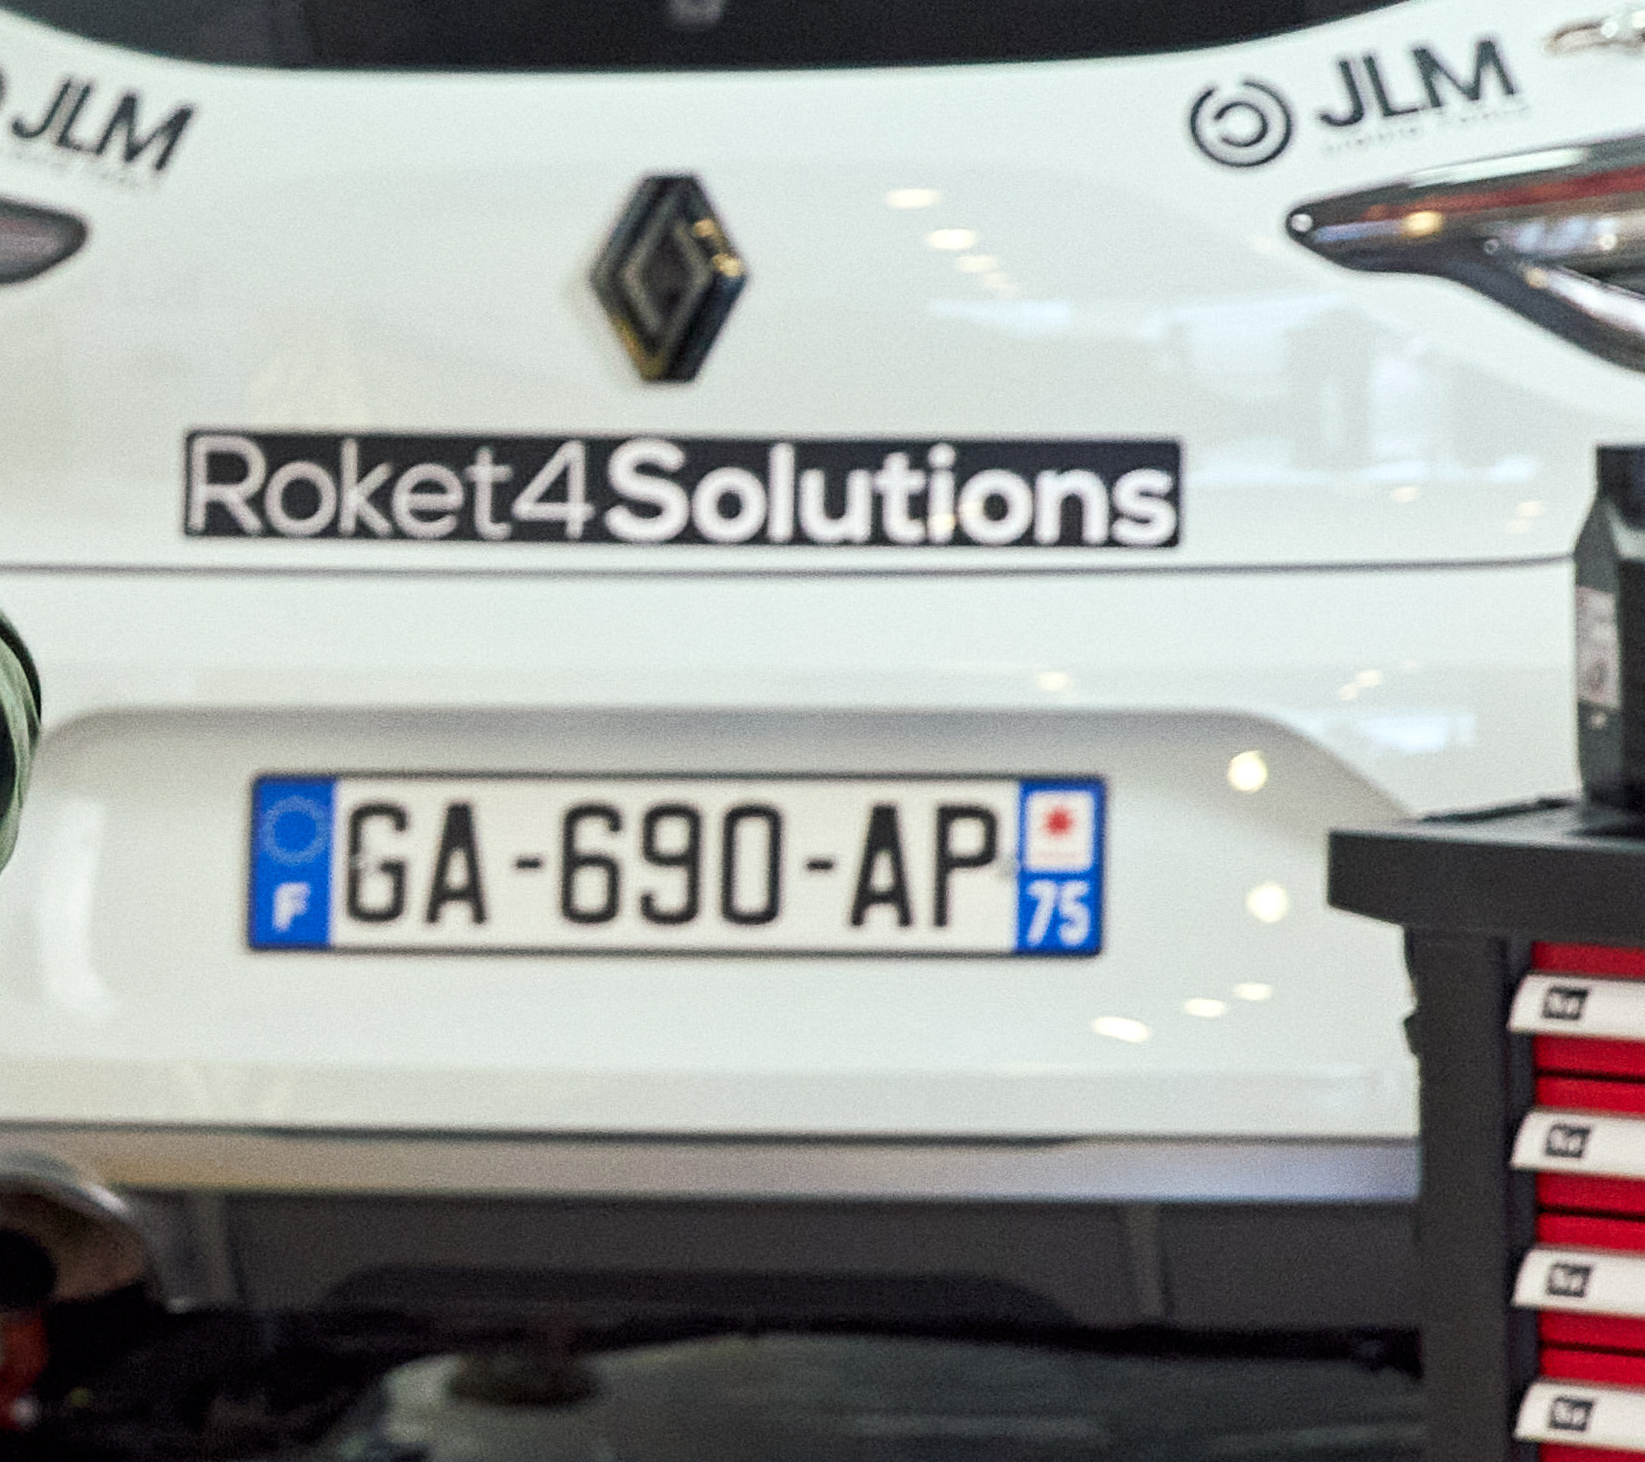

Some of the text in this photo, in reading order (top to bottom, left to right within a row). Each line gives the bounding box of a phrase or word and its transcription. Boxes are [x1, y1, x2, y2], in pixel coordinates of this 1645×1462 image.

[11, 75, 195, 173] JLM
[1319, 39, 1516, 127] JLM
[189, 435, 1177, 545] Roket4Solutions
[273, 801, 1092, 948] F GA-690-AP 75
